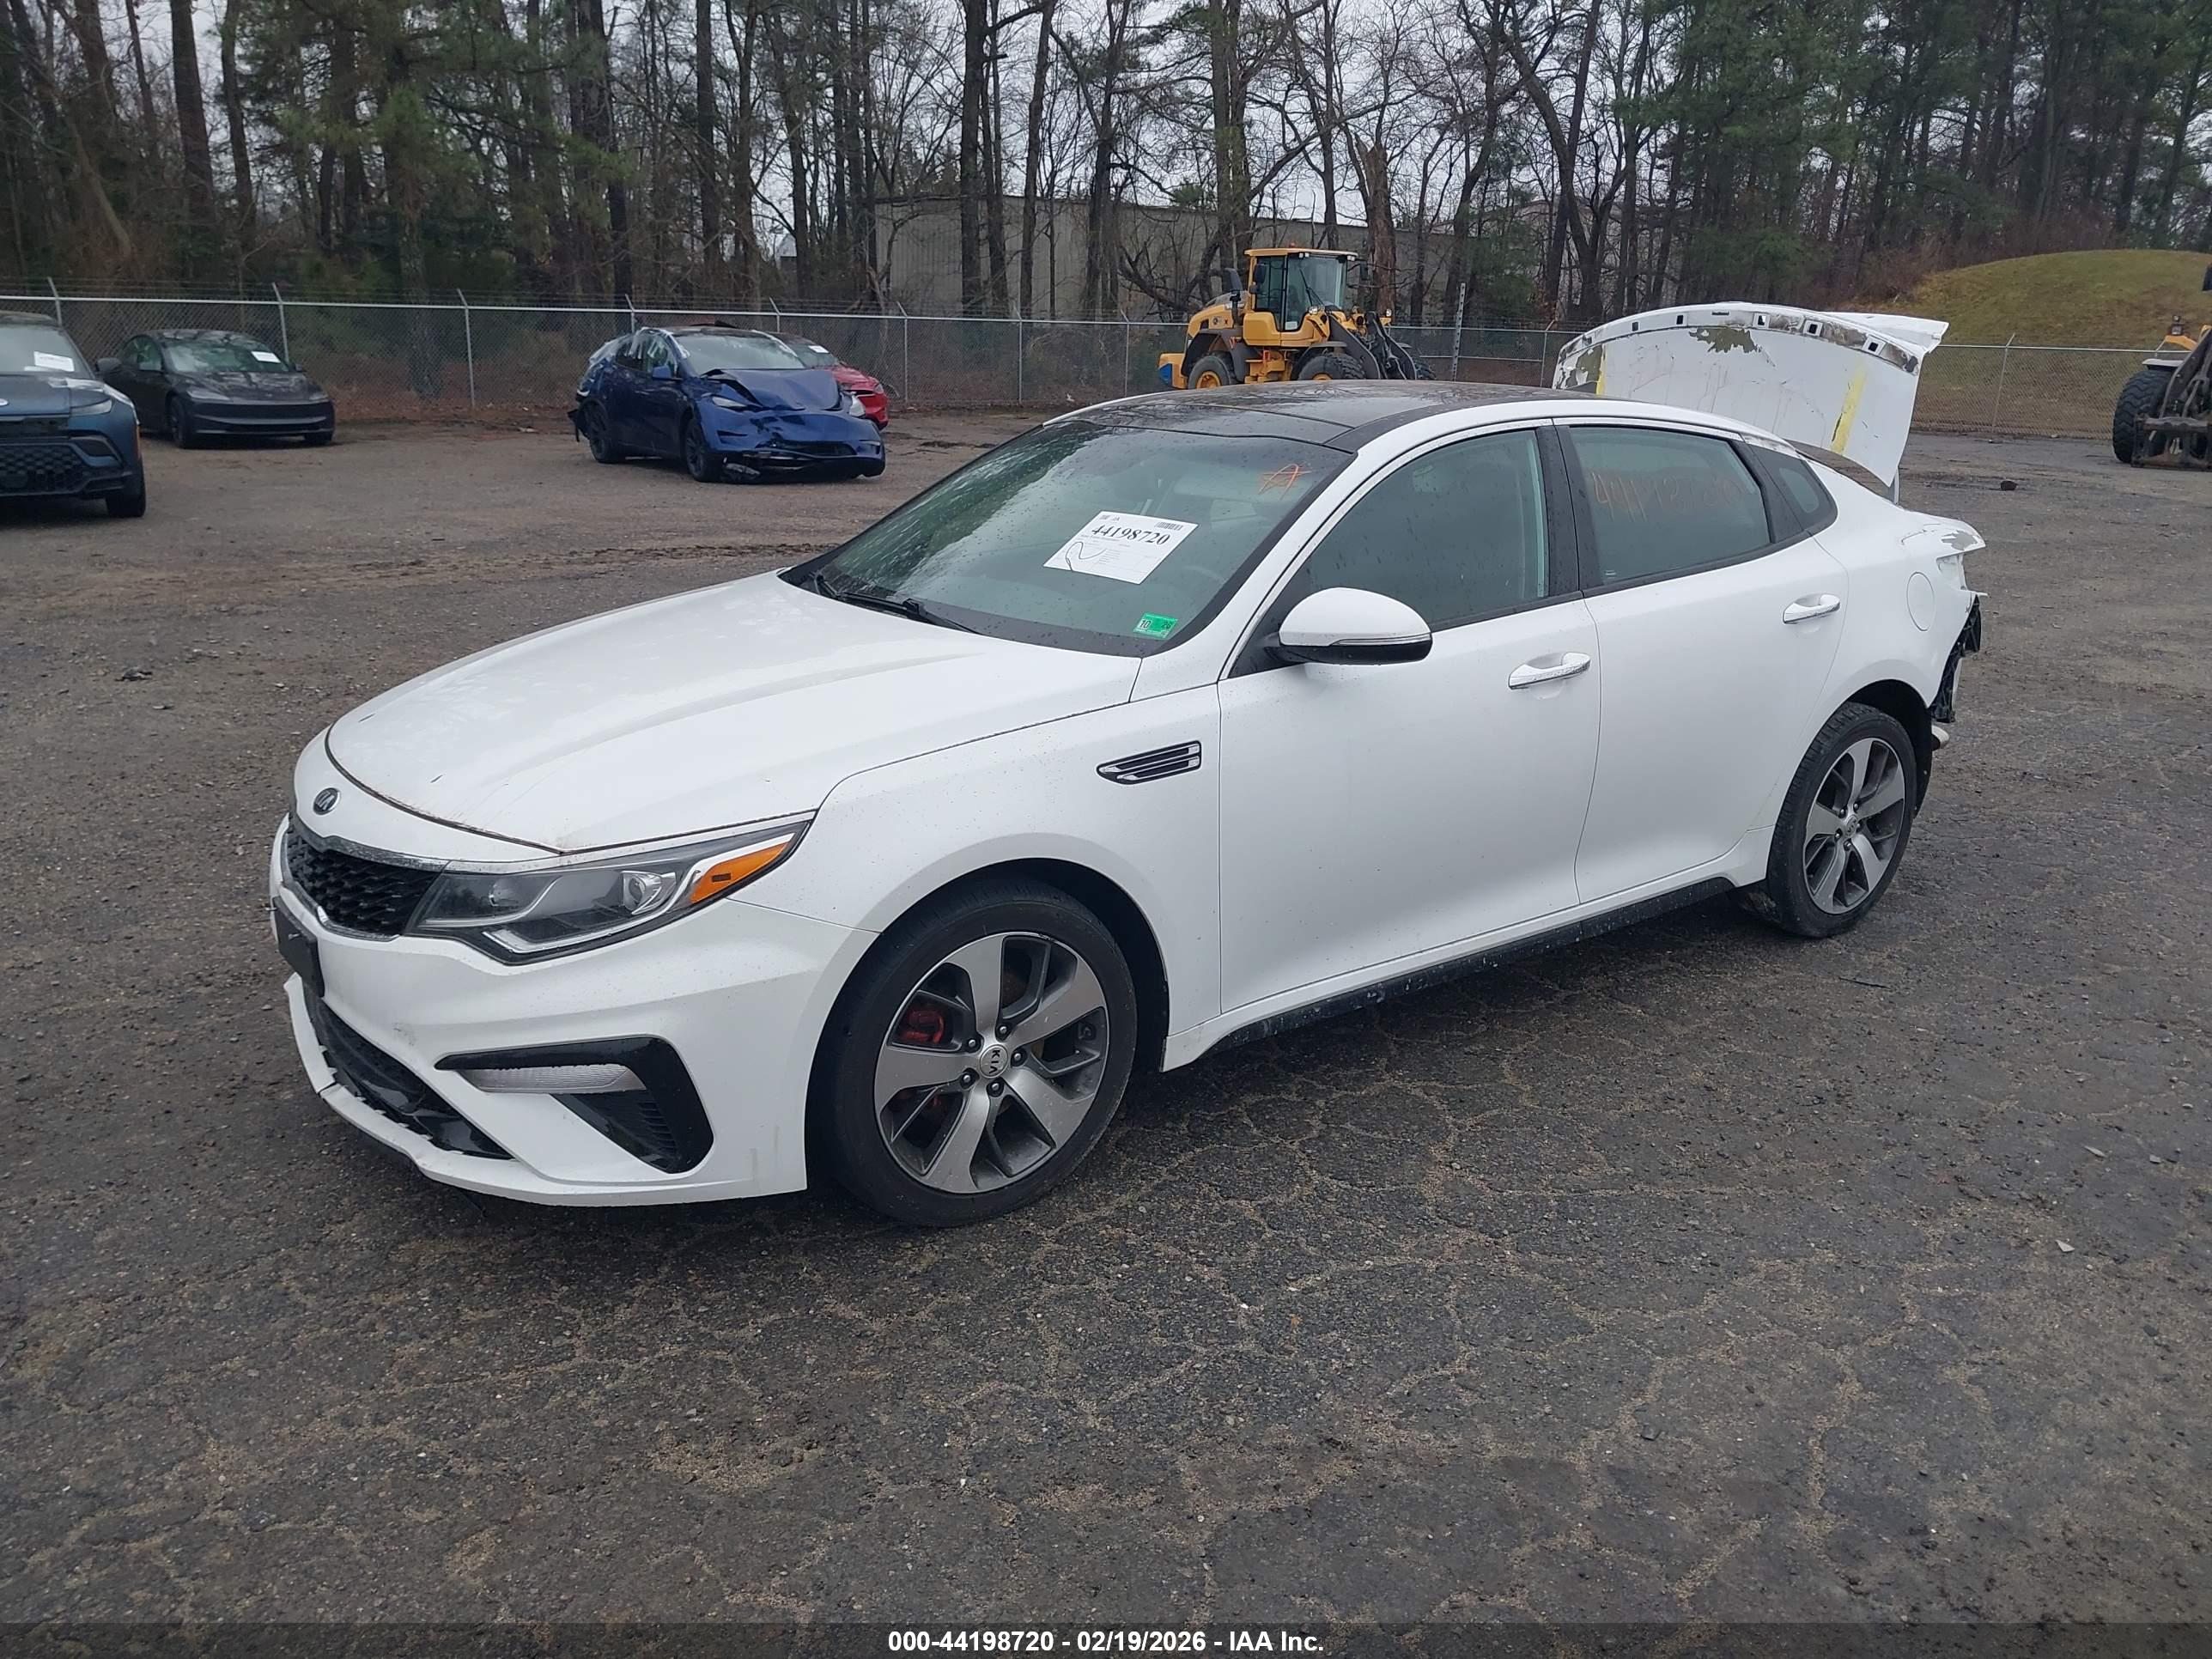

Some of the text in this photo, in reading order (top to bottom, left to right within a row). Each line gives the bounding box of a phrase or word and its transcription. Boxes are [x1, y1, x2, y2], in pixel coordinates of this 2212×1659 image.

[1091, 524, 1171, 545] 44198720
[1139, 619, 1152, 629] 10
[988, 1049, 1000, 1074] KIA
